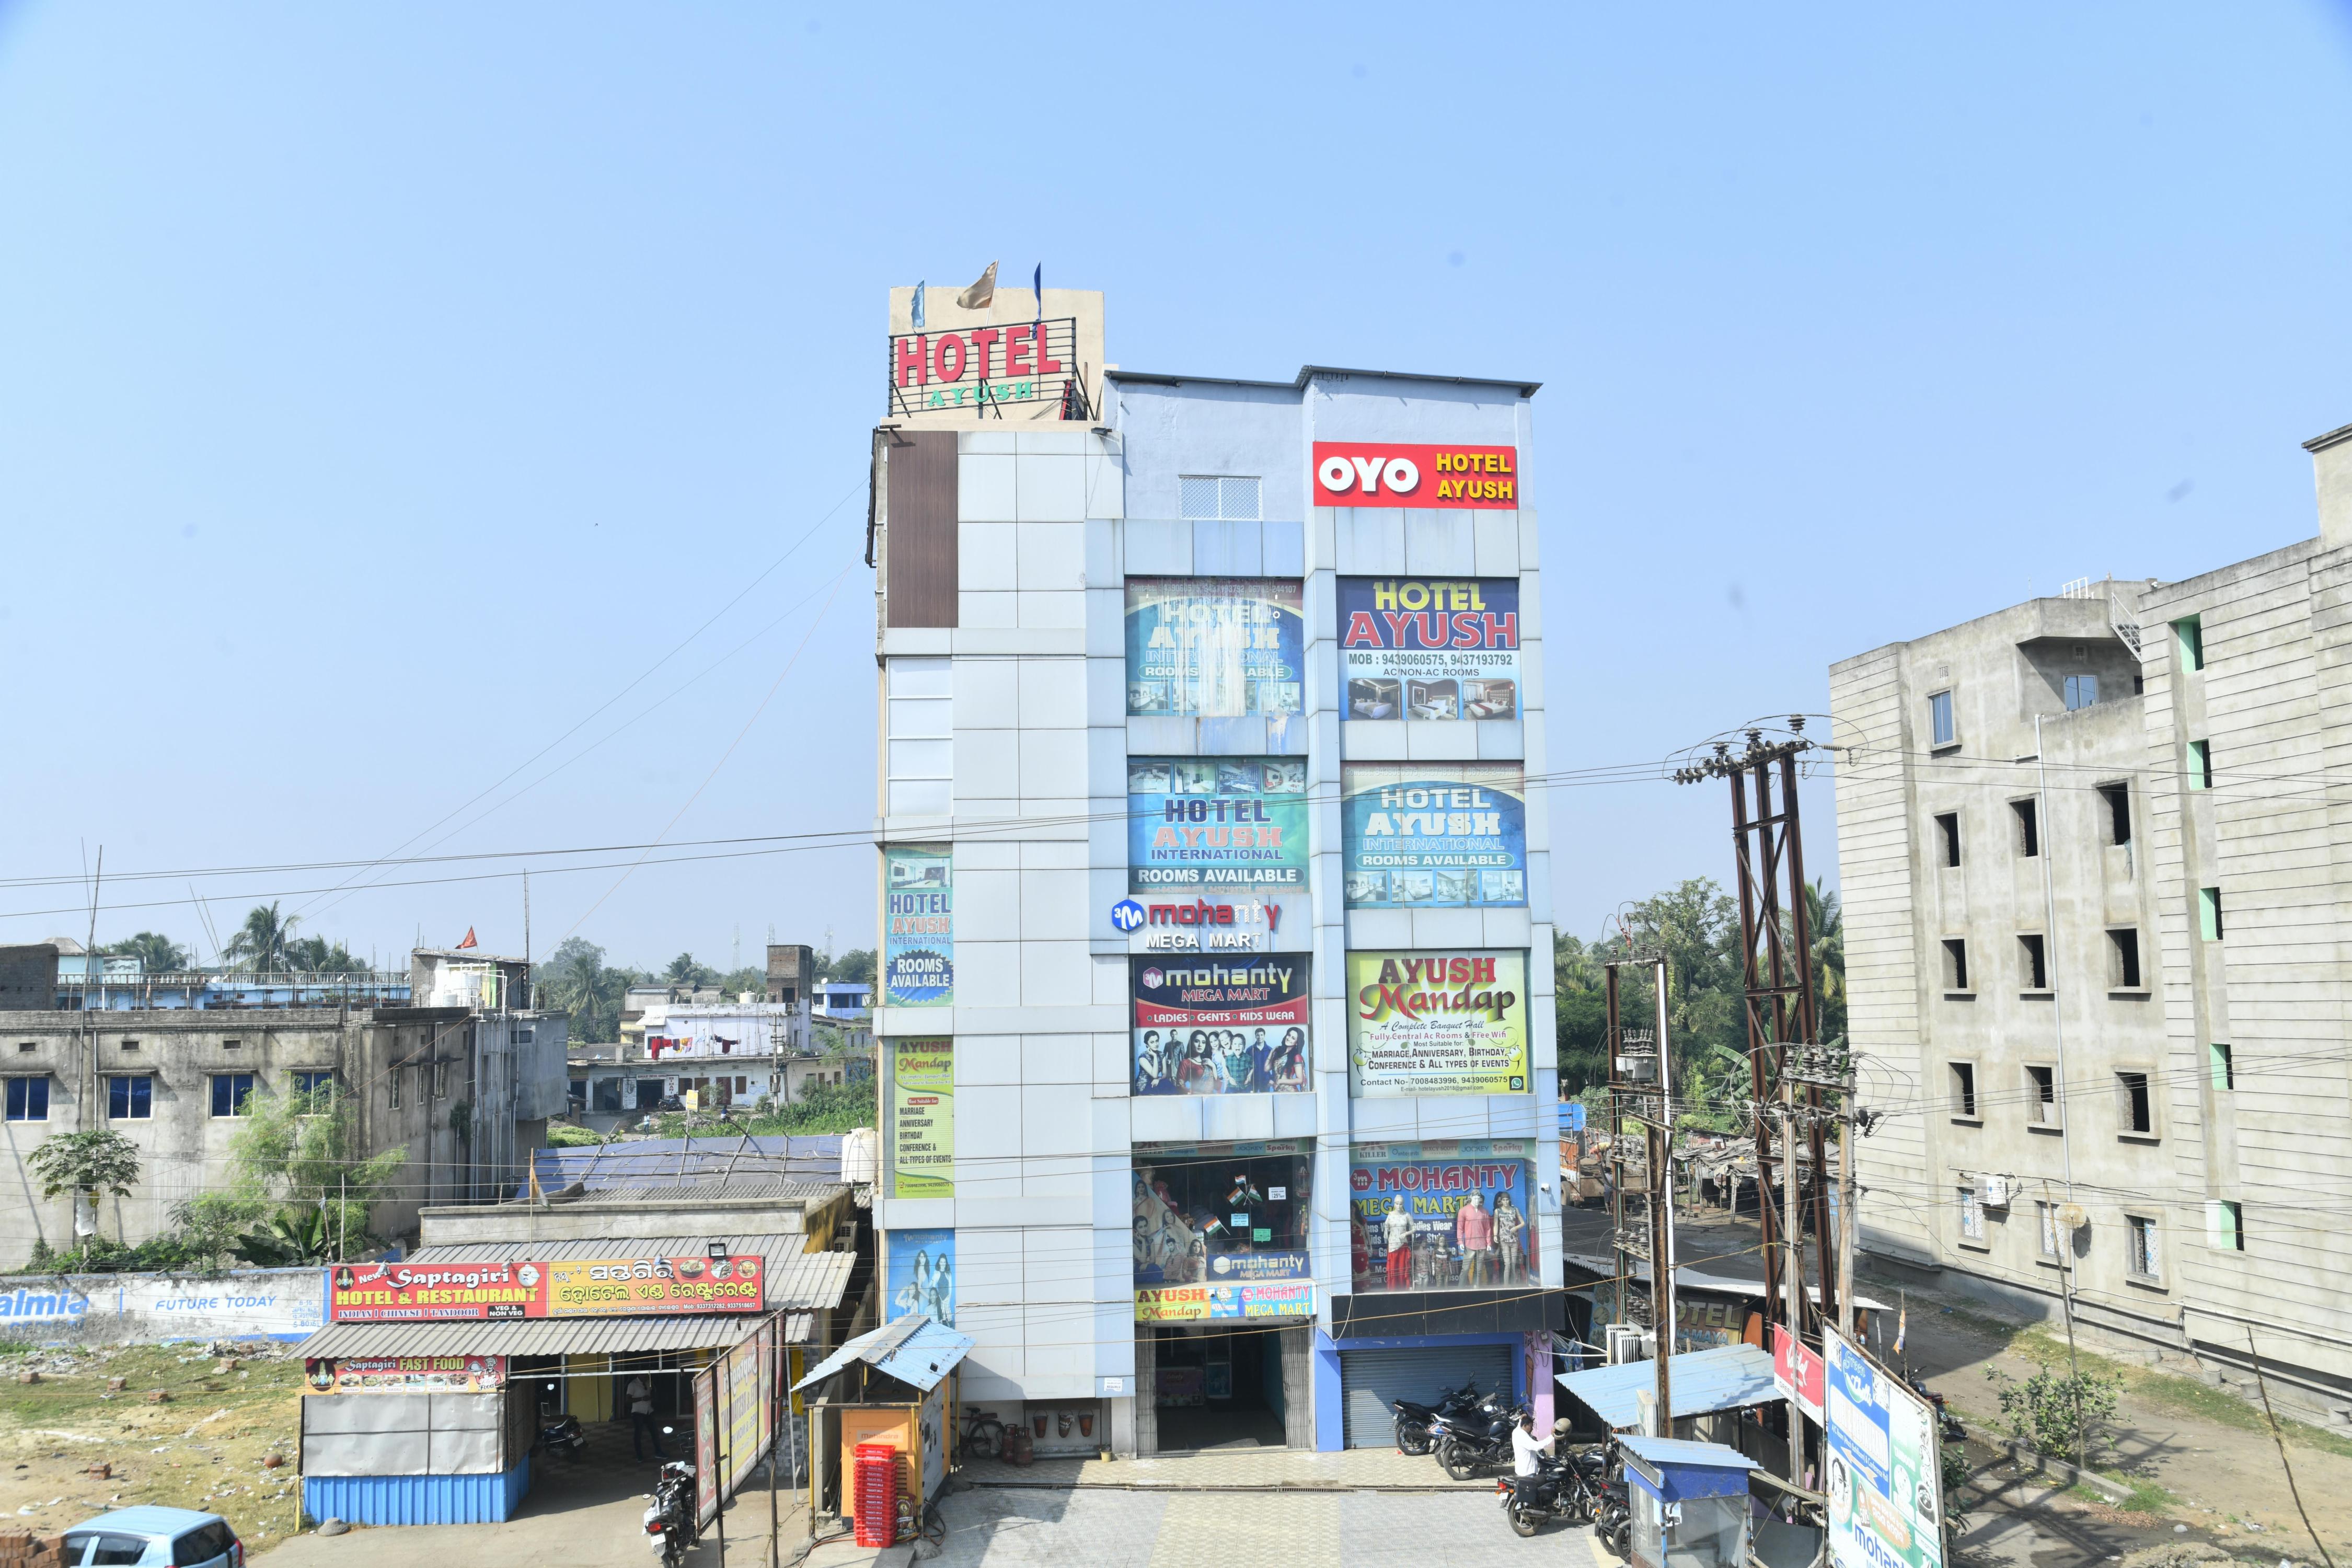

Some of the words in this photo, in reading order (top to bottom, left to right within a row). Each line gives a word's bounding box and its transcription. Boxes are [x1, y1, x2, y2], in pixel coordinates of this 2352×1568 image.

[897, 324, 1060, 387] HOTEL
[928, 382, 1032, 407] AYUSH
[1436, 453, 1512, 472] HOTEL
[1319, 456, 1419, 493] OYO
[1437, 480, 1513, 499] AYUSH
[1373, 582, 1486, 610] HOTEL
[1164, 604, 1271, 623] HOTEL
[1343, 612, 1517, 648] AYUSH
[1348, 653, 1373, 664] MOB
[1382, 653, 1448, 667] 9439060575,
[1450, 654, 1512, 665] 9437193792
[1381, 788, 1491, 809] HOTEL
[1165, 799, 1272, 823] HOTEL
[1365, 813, 1501, 836] AYUSH
[1153, 827, 1283, 847] AYUSH
[1363, 838, 1505, 851] INTERNATIONAL
[1151, 849, 1284, 860] INTERNATIONAL
[1363, 856, 1418, 866] ROOMS
[1422, 855, 1506, 866] AVAILABLE
[1138, 869, 1200, 882] ROOMS
[1204, 869, 1297, 882] AVAILABLE
[890, 893, 952, 915] HOTEL
[1149, 898, 1279, 930] mohanty
[891, 917, 950, 934] AYUSH
[890, 937, 951, 945] INTERNATIONAL
[1146, 933, 1200, 948] MEGA
[1209, 932, 1262, 947] MART
[897, 958, 943, 973] ROOMS
[1378, 958, 1496, 984] AYUSH
[891, 974, 950, 988] AVAILABLE
[1166, 962, 1293, 993] mohanty
[1181, 988, 1224, 1001] MEGA
[1227, 988, 1270, 1000] MART
[1359, 983, 1516, 1022] Mandap
[1154, 1013, 1188, 1022] LADIES
[1197, 1012, 1231, 1022] GENTS
[1240, 1012, 1263, 1021] KIDS
[1266, 1011, 1295, 1020] WEAR
[1379, 1022, 1388, 1031] A
[1391, 1021, 1427, 1031] Complete
[1430, 1021, 1463, 1031] Banquet
[1464, 1020, 1484, 1029] Hall
[898, 1041, 952, 1053] AYUSH
[1469, 1047, 1505, 1056] BIRTHDAY
[898, 1057, 951, 1071] Mandap
[1368, 1060, 1417, 1069] CONFERENCE
[1419, 1060, 1426, 1068] &
[1428, 1059, 1443, 1068] ALL
[1445, 1060, 1468, 1068] TYPES
[900, 1107, 925, 1115] MARRIAGE
[900, 1119, 933, 1127] ANNIVERSARY
[900, 1131, 923, 1140] BIRTHDAY
[900, 1144, 931, 1152] CONFERENCE
[1493, 1144, 1523, 1153] Sparky
[900, 1156, 908, 1164] ALL
[926, 1155, 932, 1163] OF
[933, 1155, 951, 1163] EVENTS
[1377, 1164, 1517, 1193] MOHANTY
[1412, 1195, 1468, 1214] MART
[1433, 1221, 1452, 1230] Wear
[589, 1260, 674, 1281] ସପ୍ତଗିରି
[1231, 1254, 1304, 1272] mohanty
[387, 1267, 510, 1289] Saptagiri
[336, 1290, 394, 1306] HOTEL
[398, 1293, 412, 1305] &
[417, 1288, 538, 1305] RESTAURANT
[560, 1284, 630, 1304] ହୋଟେଲ
[1137, 1288, 1205, 1302] AYUSH
[1255, 1285, 1309, 1301] MOHANTY
[156, 1298, 218, 1310] FUTURE
[226, 1295, 277, 1308] TODAY
[1245, 1304, 1274, 1317] MEGA
[1279, 1302, 1310, 1316] MART
[338, 1310, 373, 1318] INDIAN
[381, 1309, 422, 1318] CHINESE
[430, 1308, 479, 1317] TANDOOR
[1142, 1305, 1201, 1320] Mandap
[345, 1359, 396, 1371] Saptagiri
[399, 1358, 429, 1370] FAST
[433, 1357, 465, 1370] FOOD
[1779, 1381, 1793, 1397] GREEN
